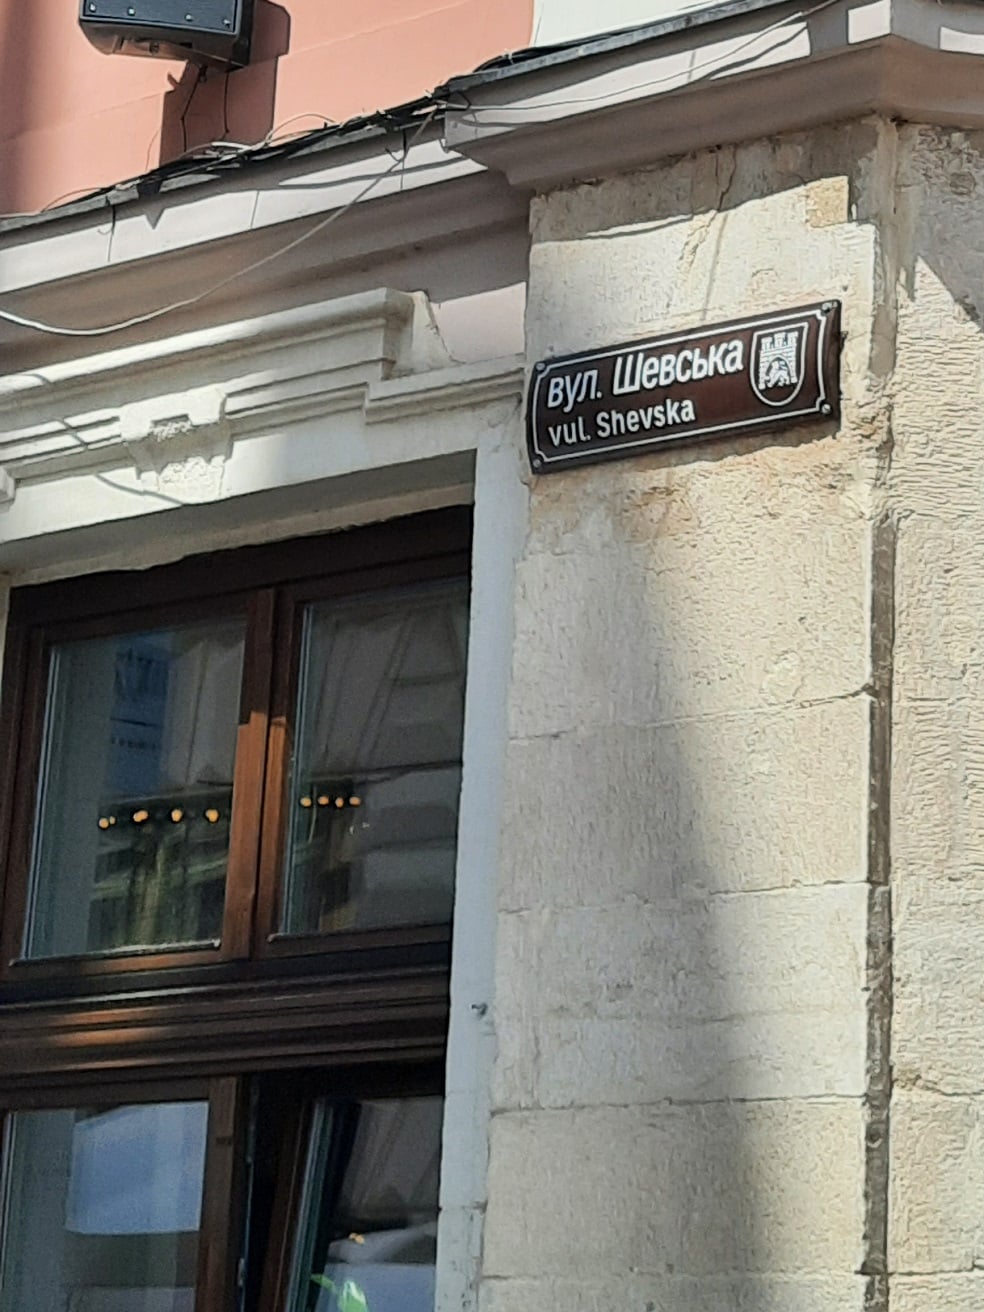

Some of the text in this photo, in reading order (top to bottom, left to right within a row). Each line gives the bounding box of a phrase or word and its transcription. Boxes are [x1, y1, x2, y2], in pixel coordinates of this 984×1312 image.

[547, 339, 744, 413] вул. Шевська
[548, 398, 696, 448] vul. Shevska
